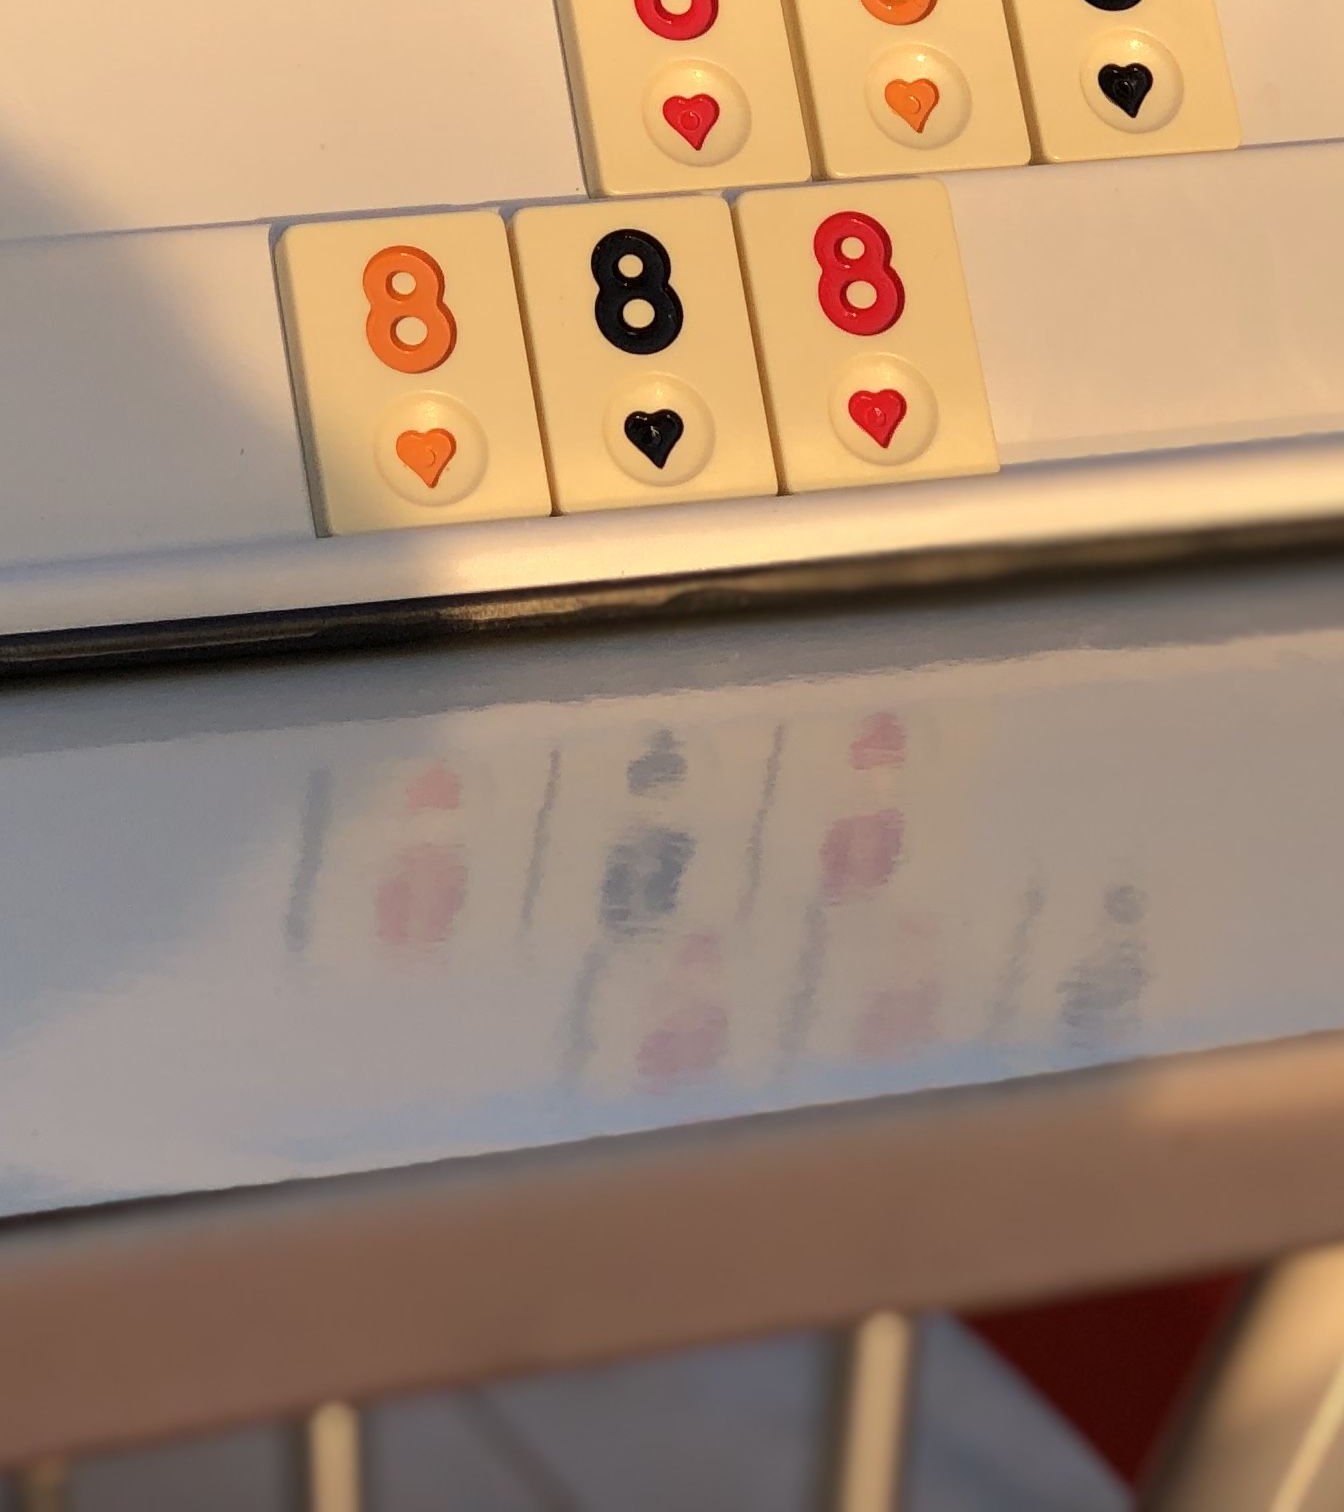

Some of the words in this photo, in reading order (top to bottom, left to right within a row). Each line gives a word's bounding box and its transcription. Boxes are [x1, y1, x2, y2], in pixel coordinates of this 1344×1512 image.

[362, 245, 457, 374] 8
[590, 229, 684, 356] 8
[813, 210, 905, 337] 8
